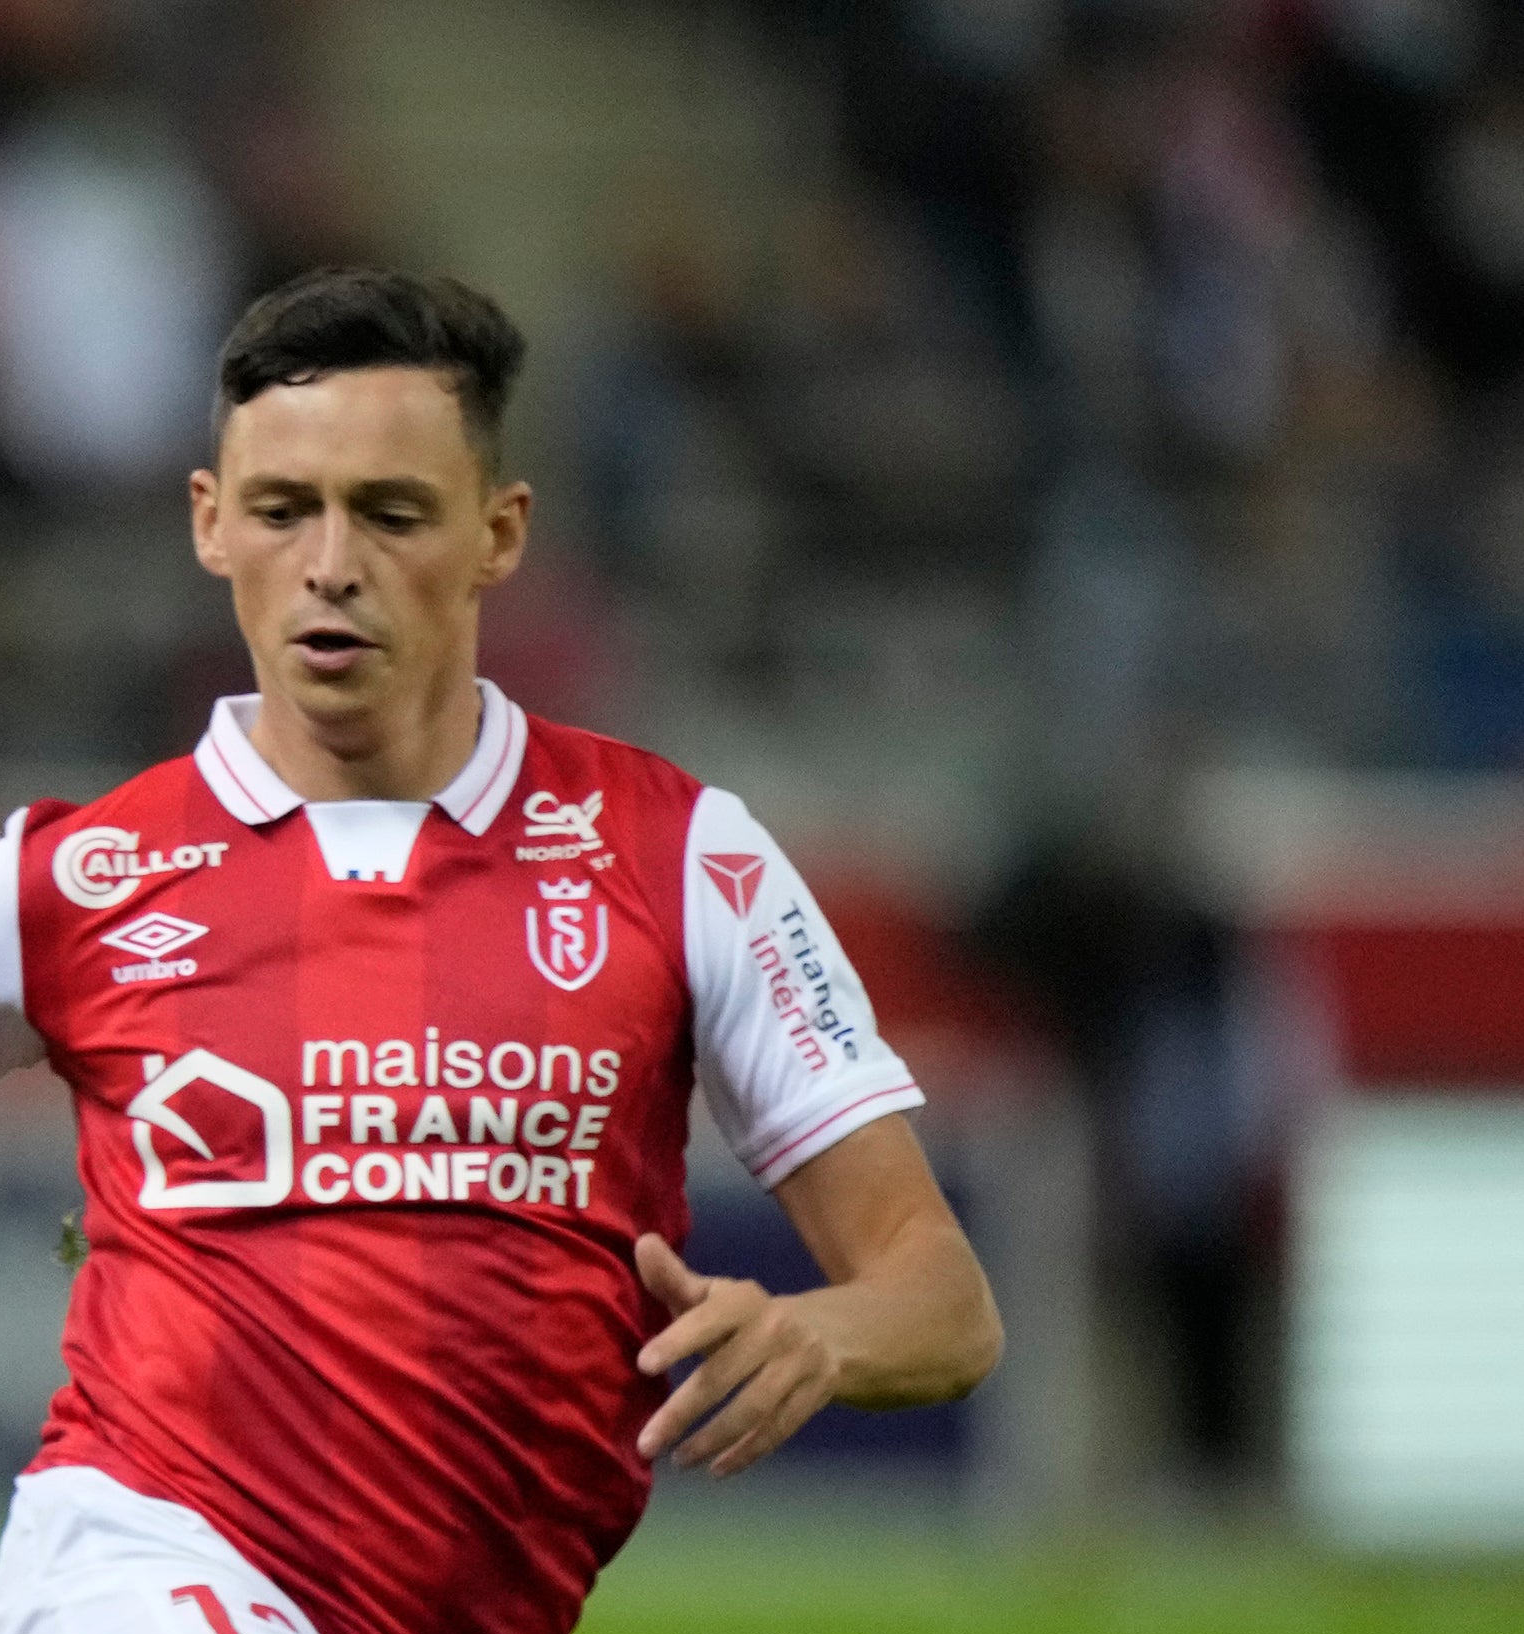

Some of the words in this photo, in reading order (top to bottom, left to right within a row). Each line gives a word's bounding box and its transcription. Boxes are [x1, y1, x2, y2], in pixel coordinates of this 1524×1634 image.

[52, 826, 230, 910] CAILLOT
[111, 957, 199, 984] umbro
[749, 929, 829, 1071] intérim
[781, 900, 859, 1061] Triangle
[302, 1026, 622, 1098] maisons
[302, 1094, 612, 1150] FRANCE
[302, 1152, 596, 1209] CONFORT
